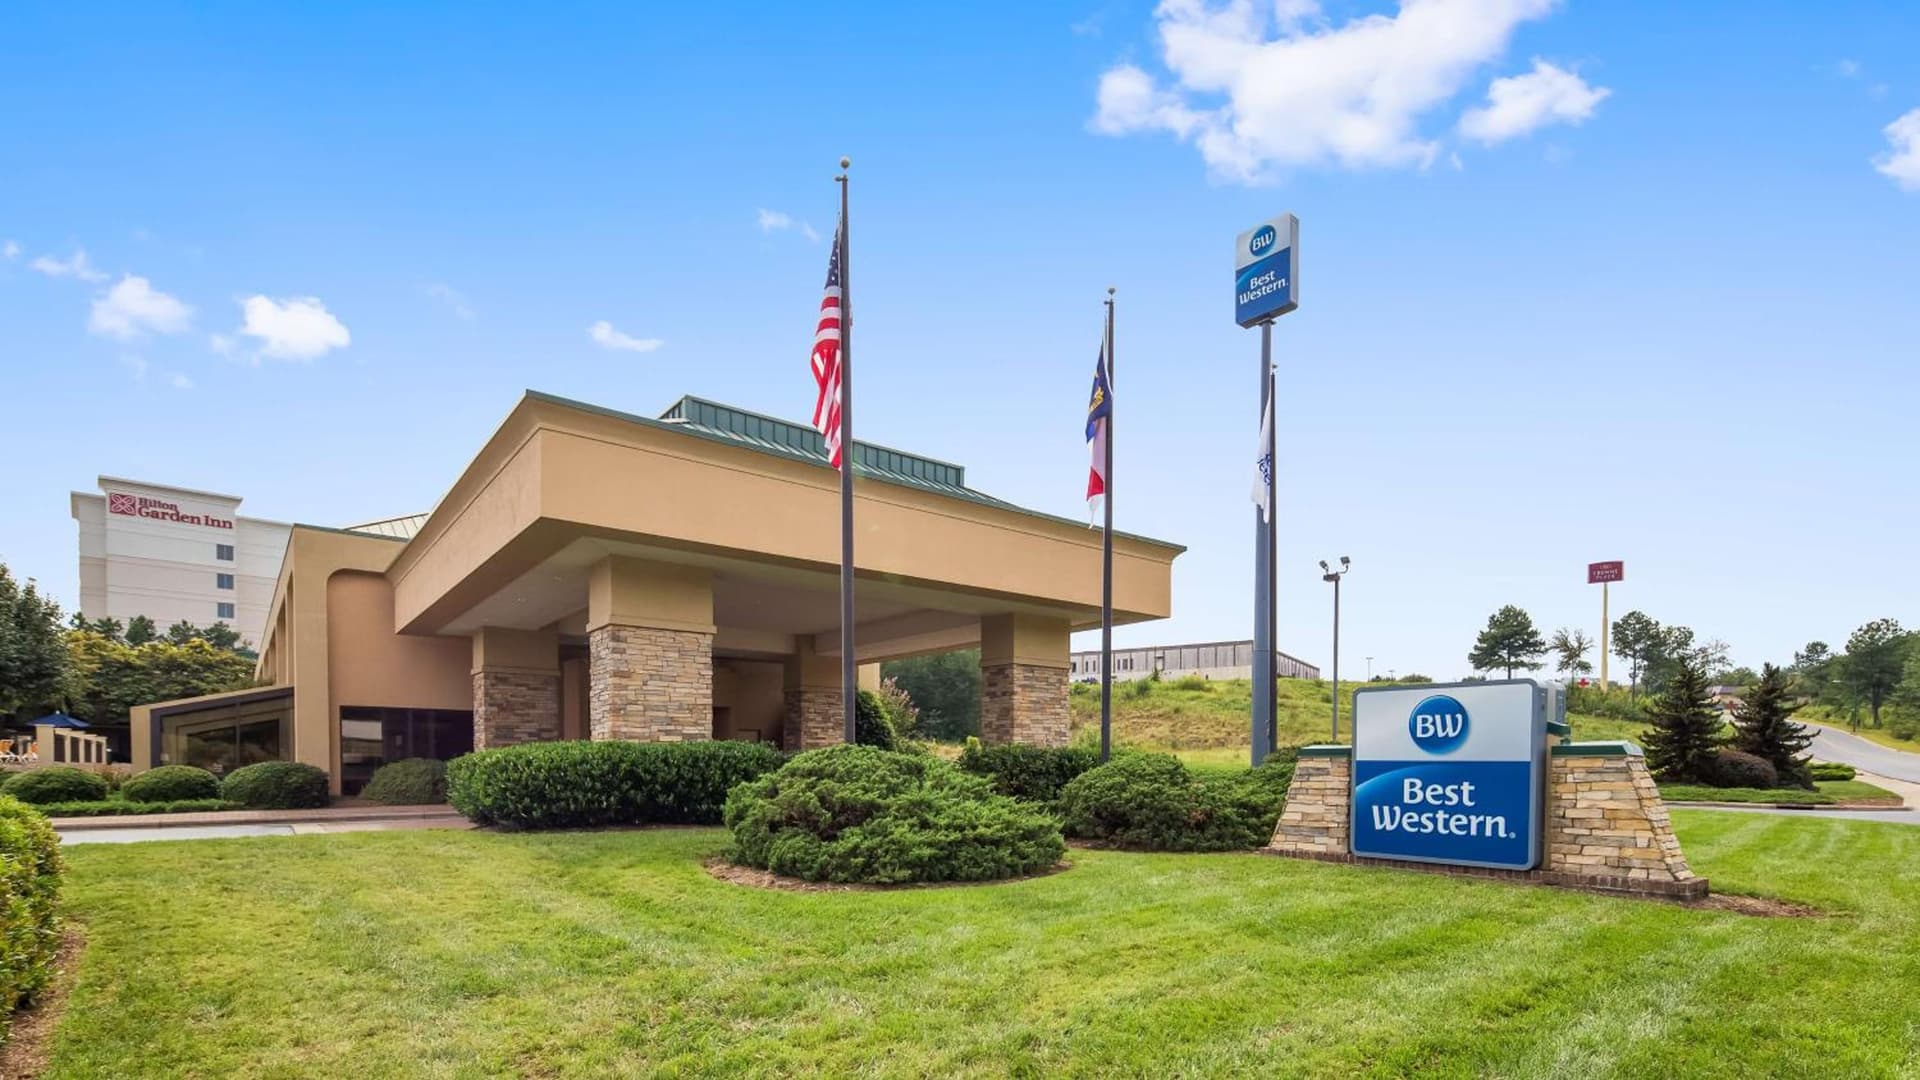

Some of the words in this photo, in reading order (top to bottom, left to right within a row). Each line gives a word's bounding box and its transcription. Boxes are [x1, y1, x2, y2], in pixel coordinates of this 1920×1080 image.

[1252, 231, 1274, 252] BW
[1249, 270, 1276, 290] Best
[138, 497, 178, 511] Hilton
[138, 506, 201, 526] Garden
[203, 514, 233, 529] Inn
[1416, 713, 1463, 738] BW
[1403, 778, 1476, 806] Best
